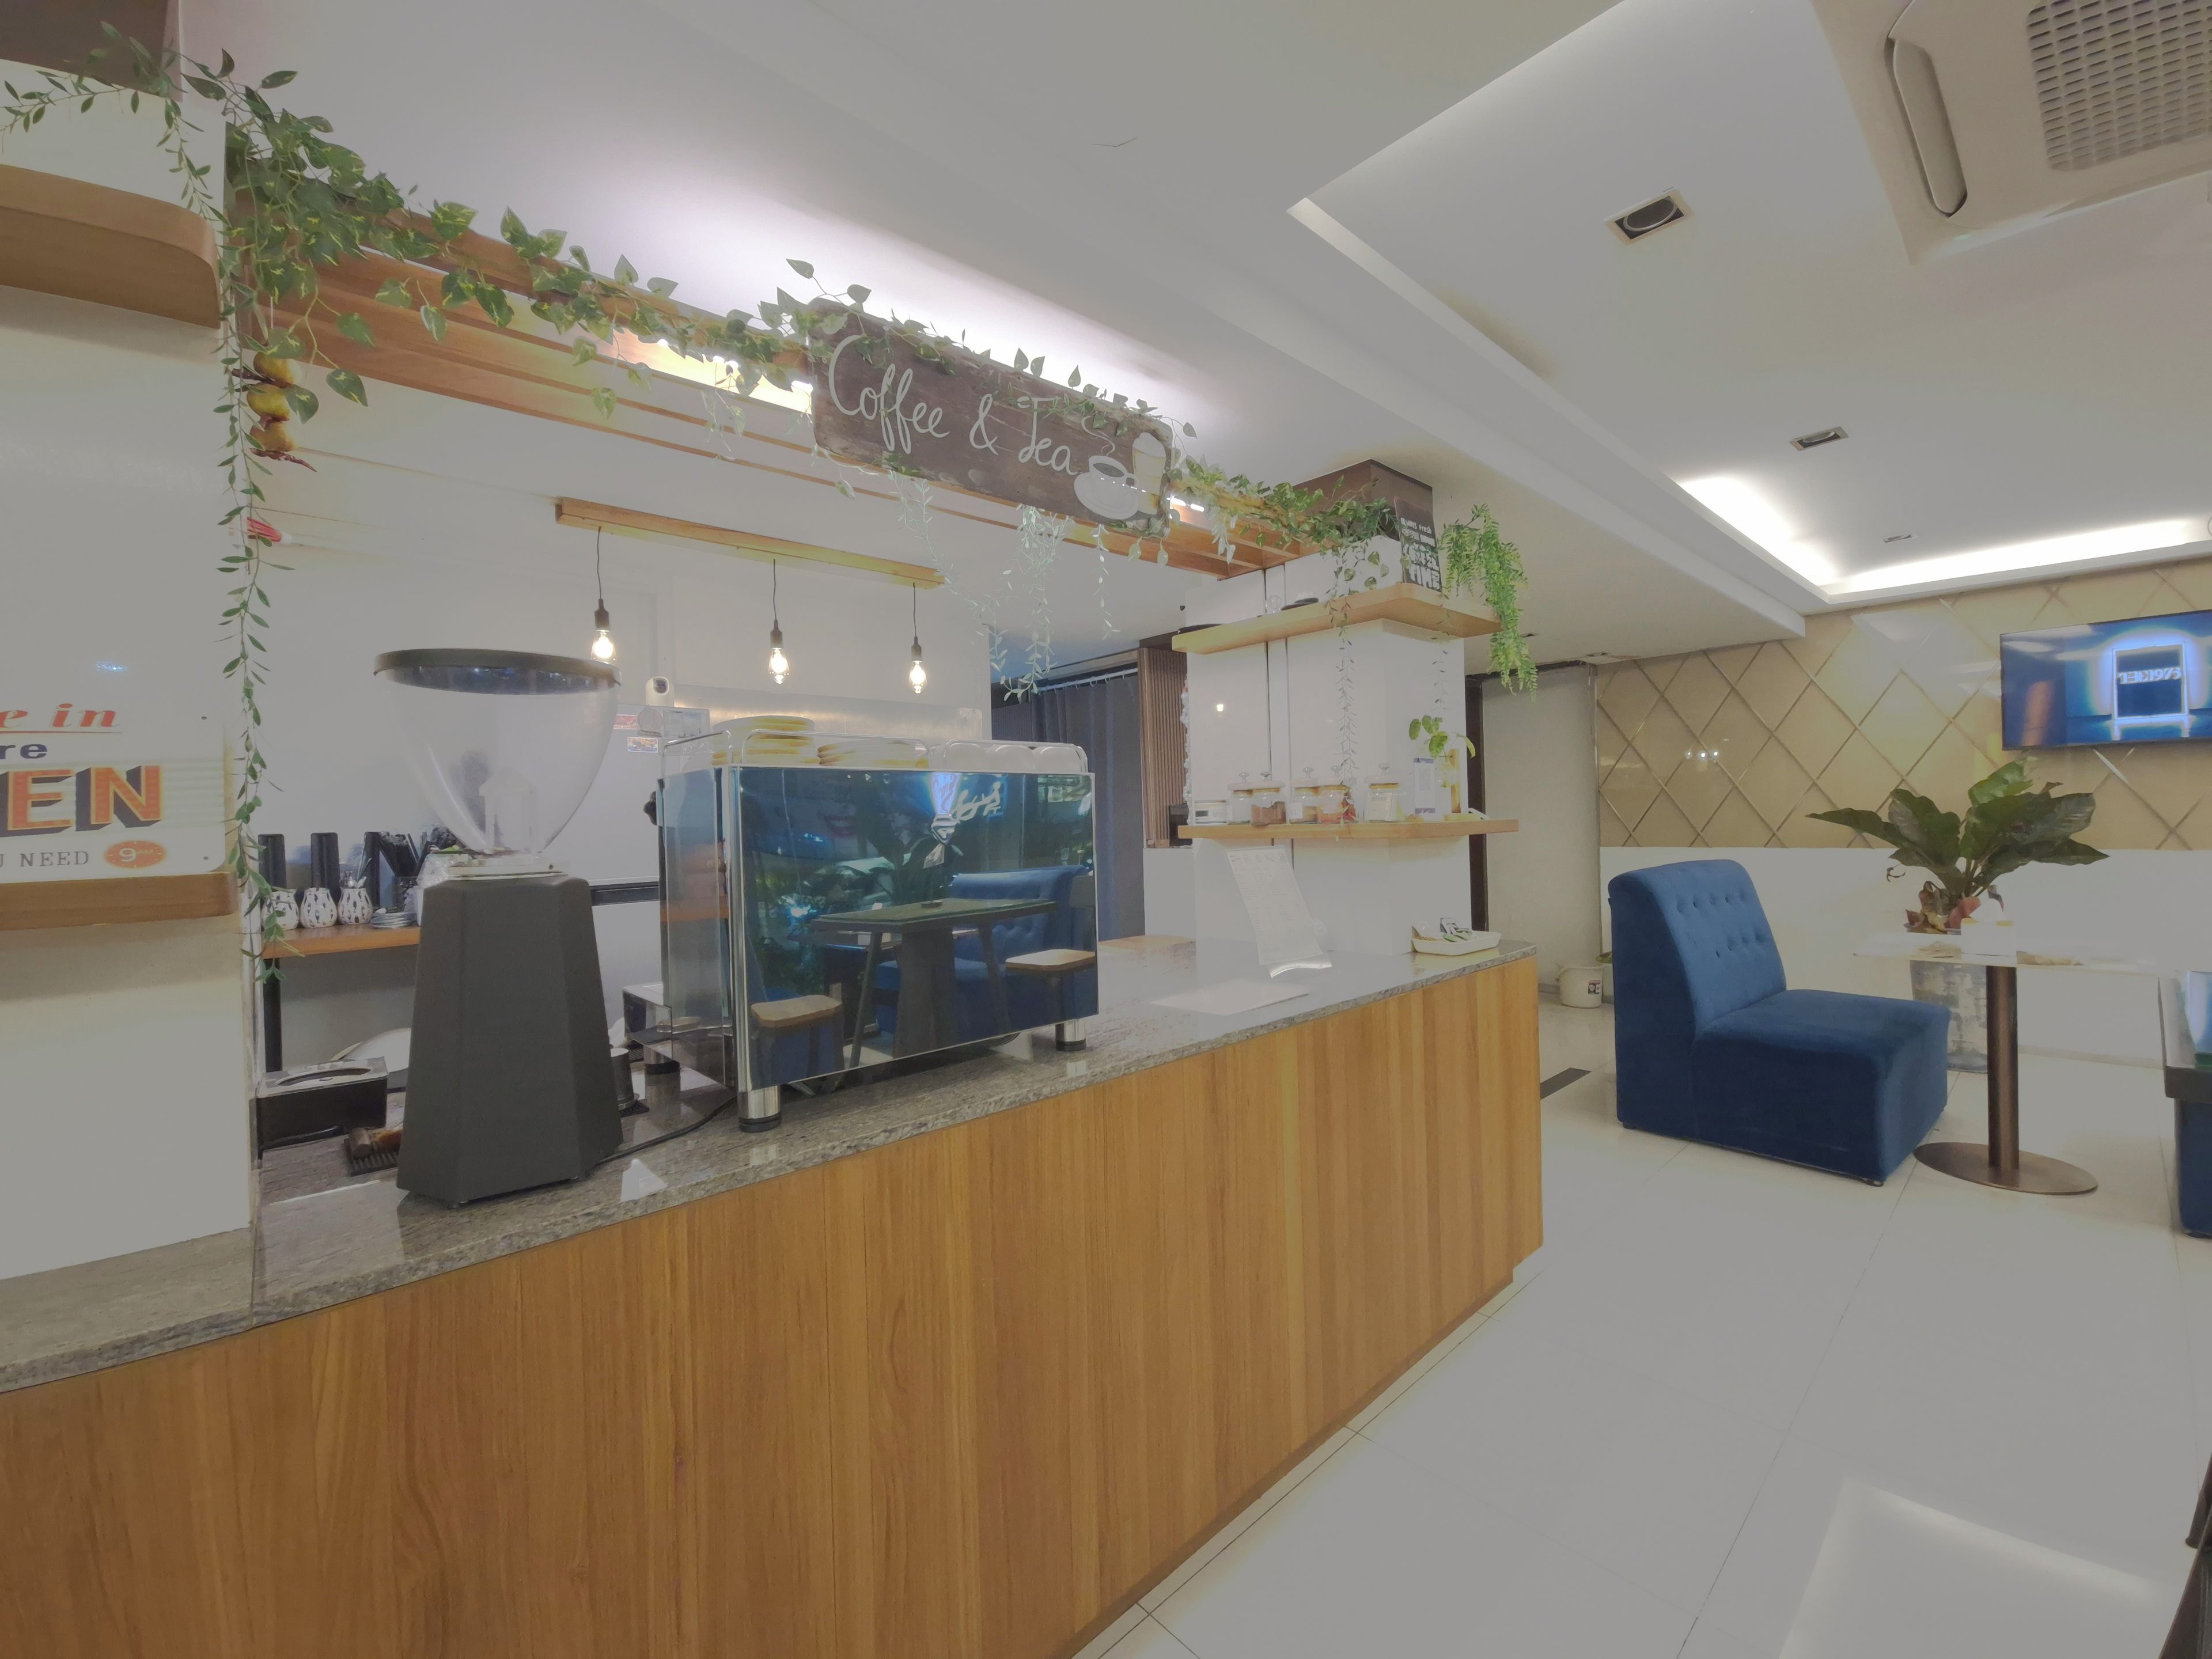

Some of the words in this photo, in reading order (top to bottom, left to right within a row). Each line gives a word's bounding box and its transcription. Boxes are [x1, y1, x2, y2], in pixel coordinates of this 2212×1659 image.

[828, 335, 951, 454] Coffee
[969, 393, 999, 456] &
[1016, 396, 1081, 476] Tea
[49, 703, 120, 729] in
[20, 851, 89, 867] NEED
